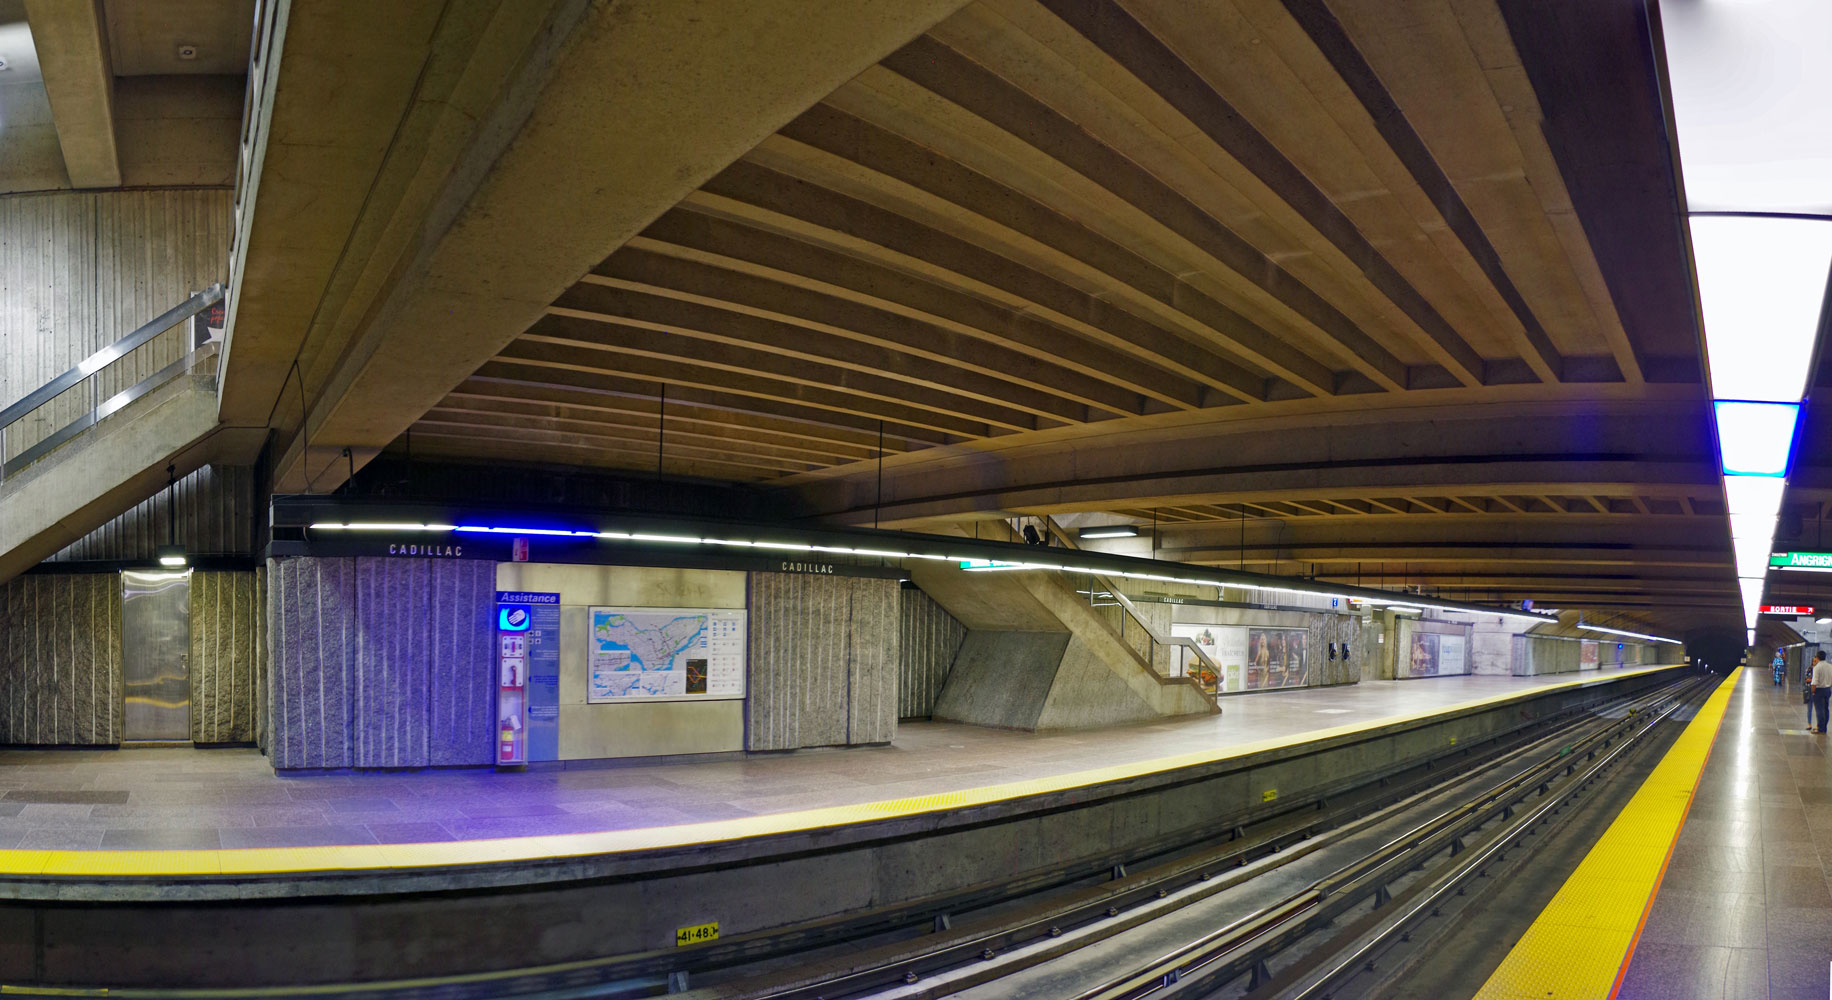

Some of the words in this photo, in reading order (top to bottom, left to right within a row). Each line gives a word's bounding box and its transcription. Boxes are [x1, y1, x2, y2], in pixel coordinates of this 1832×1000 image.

[389, 544, 463, 557] CADILLAC
[782, 562, 833, 574] CADILLAC
[501, 592, 557, 603] Assistance
